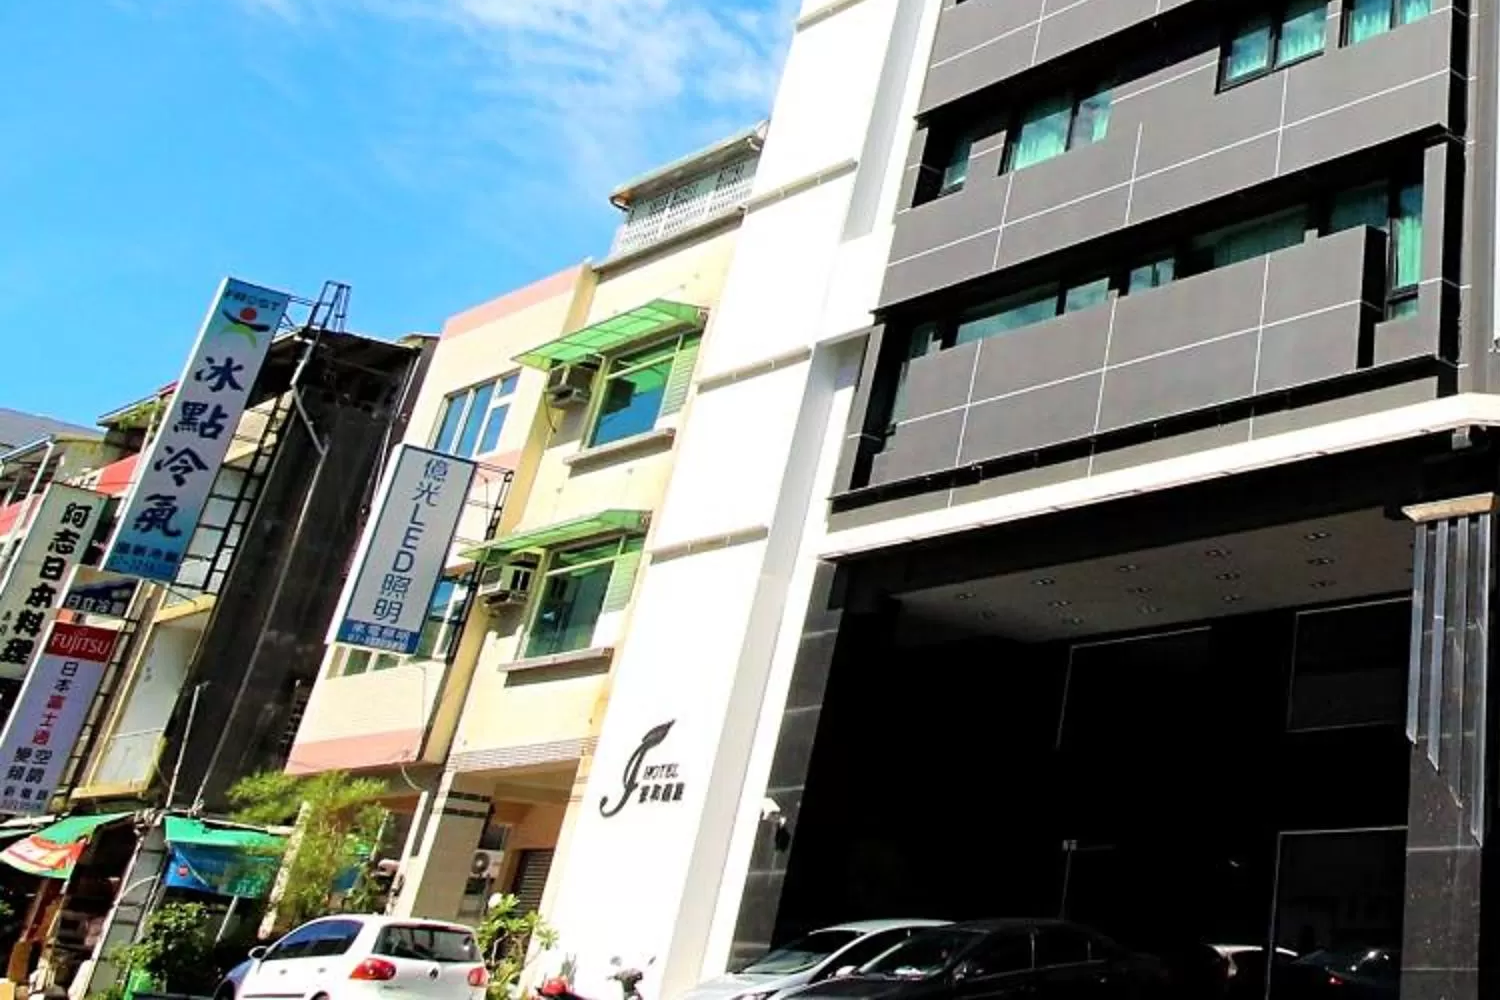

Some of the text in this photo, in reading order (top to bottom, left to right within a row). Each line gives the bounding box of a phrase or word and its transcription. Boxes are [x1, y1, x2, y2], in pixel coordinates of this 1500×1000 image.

[132, 355, 245, 537] 冰點冷氣
[0, 502, 92, 664] 阿志日本料理
[373, 458, 448, 624] 億光LED照明
[50, 630, 111, 656] FUJITSU
[643, 762, 680, 781] HOTEL
